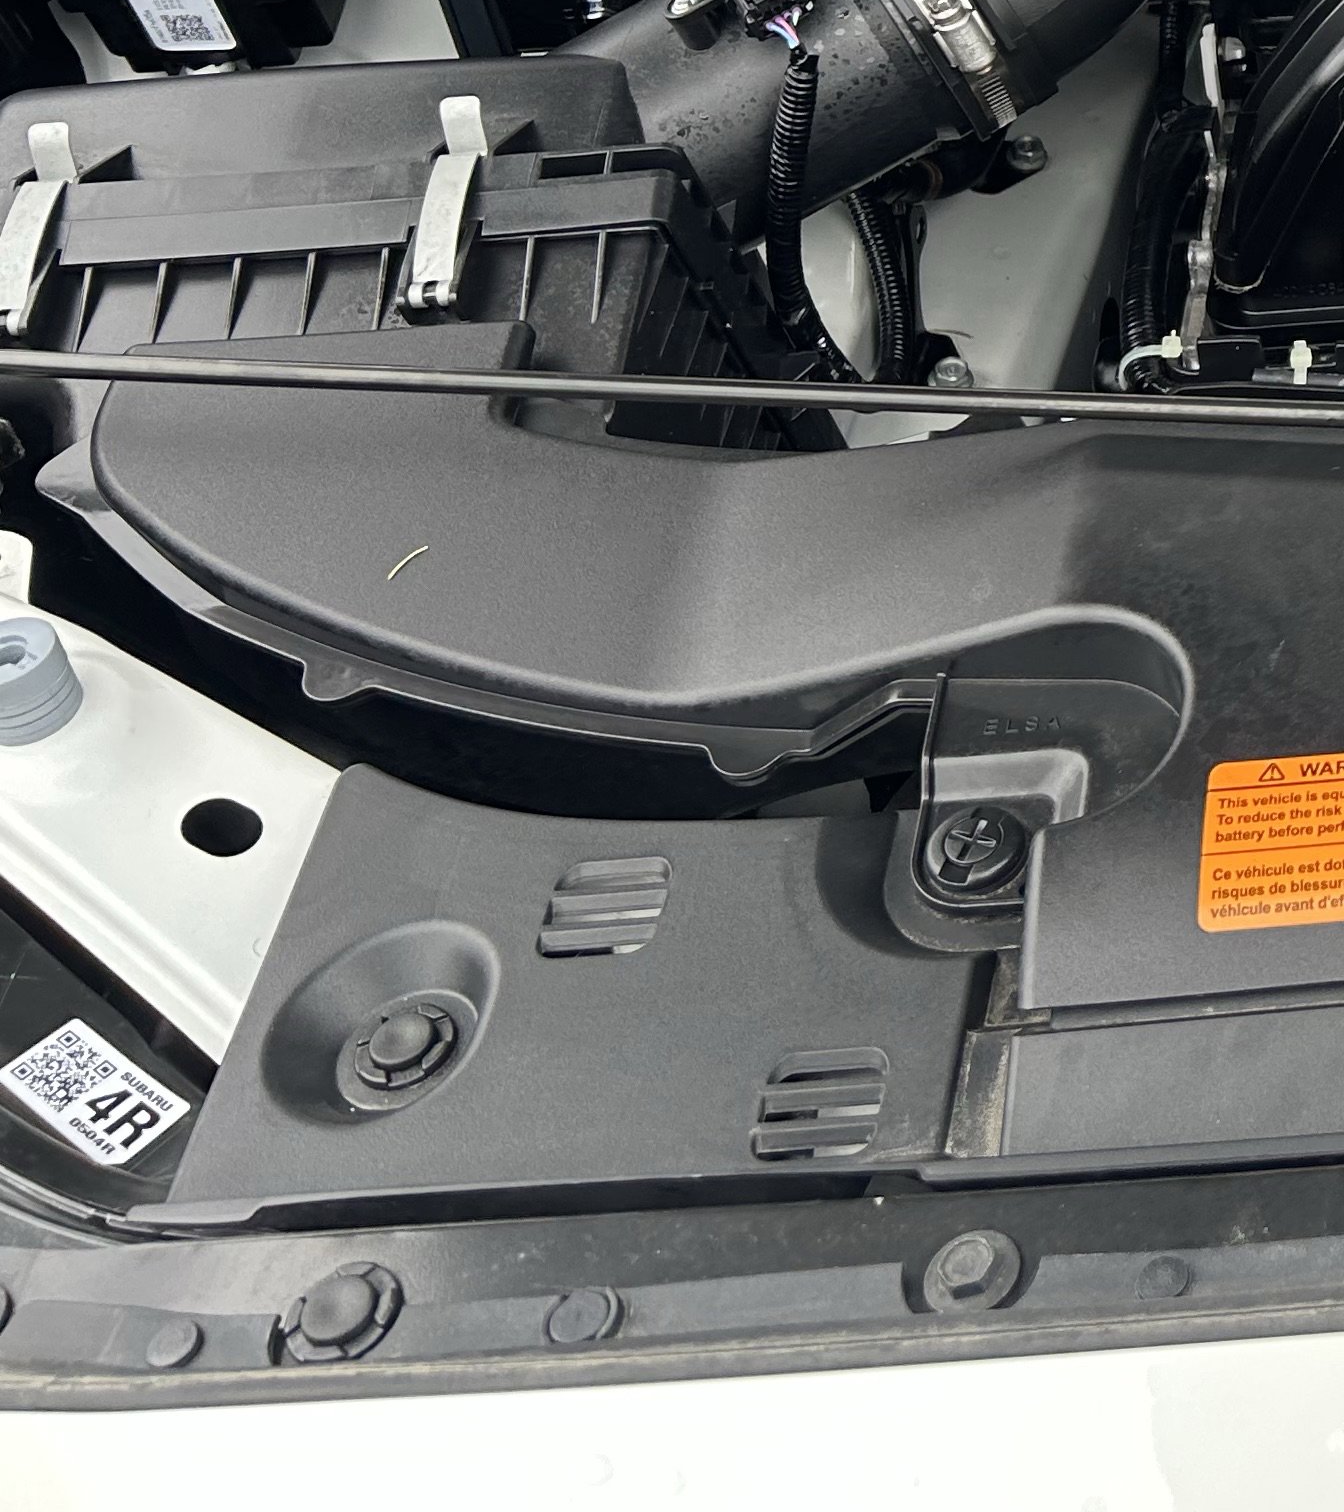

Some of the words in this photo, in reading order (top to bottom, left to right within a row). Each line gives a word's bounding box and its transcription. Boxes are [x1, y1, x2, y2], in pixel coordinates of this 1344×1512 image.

[1218, 797, 1248, 810] This
[1253, 793, 1302, 807] vehicle
[1306, 790, 1317, 802] is
[1217, 814, 1233, 826] To
[1237, 811, 1285, 824] reduce
[1290, 807, 1311, 819] the
[1316, 805, 1342, 817] risk
[1215, 829, 1265, 844] battery
[1268, 825, 1313, 839] before
[1213, 868, 1231, 882] Ce
[1236, 863, 1294, 880] véhicule
[1298, 861, 1320, 874] est
[1211, 886, 1265, 902] risques
[1269, 882, 1286, 895] de
[1210, 900, 1271, 918] véhicule
[1275, 898, 1314, 913] avant
[121, 1072, 174, 1112] SUBARU
[85, 1089, 162, 1150] 4R
[69, 1117, 116, 1155] 0504R
